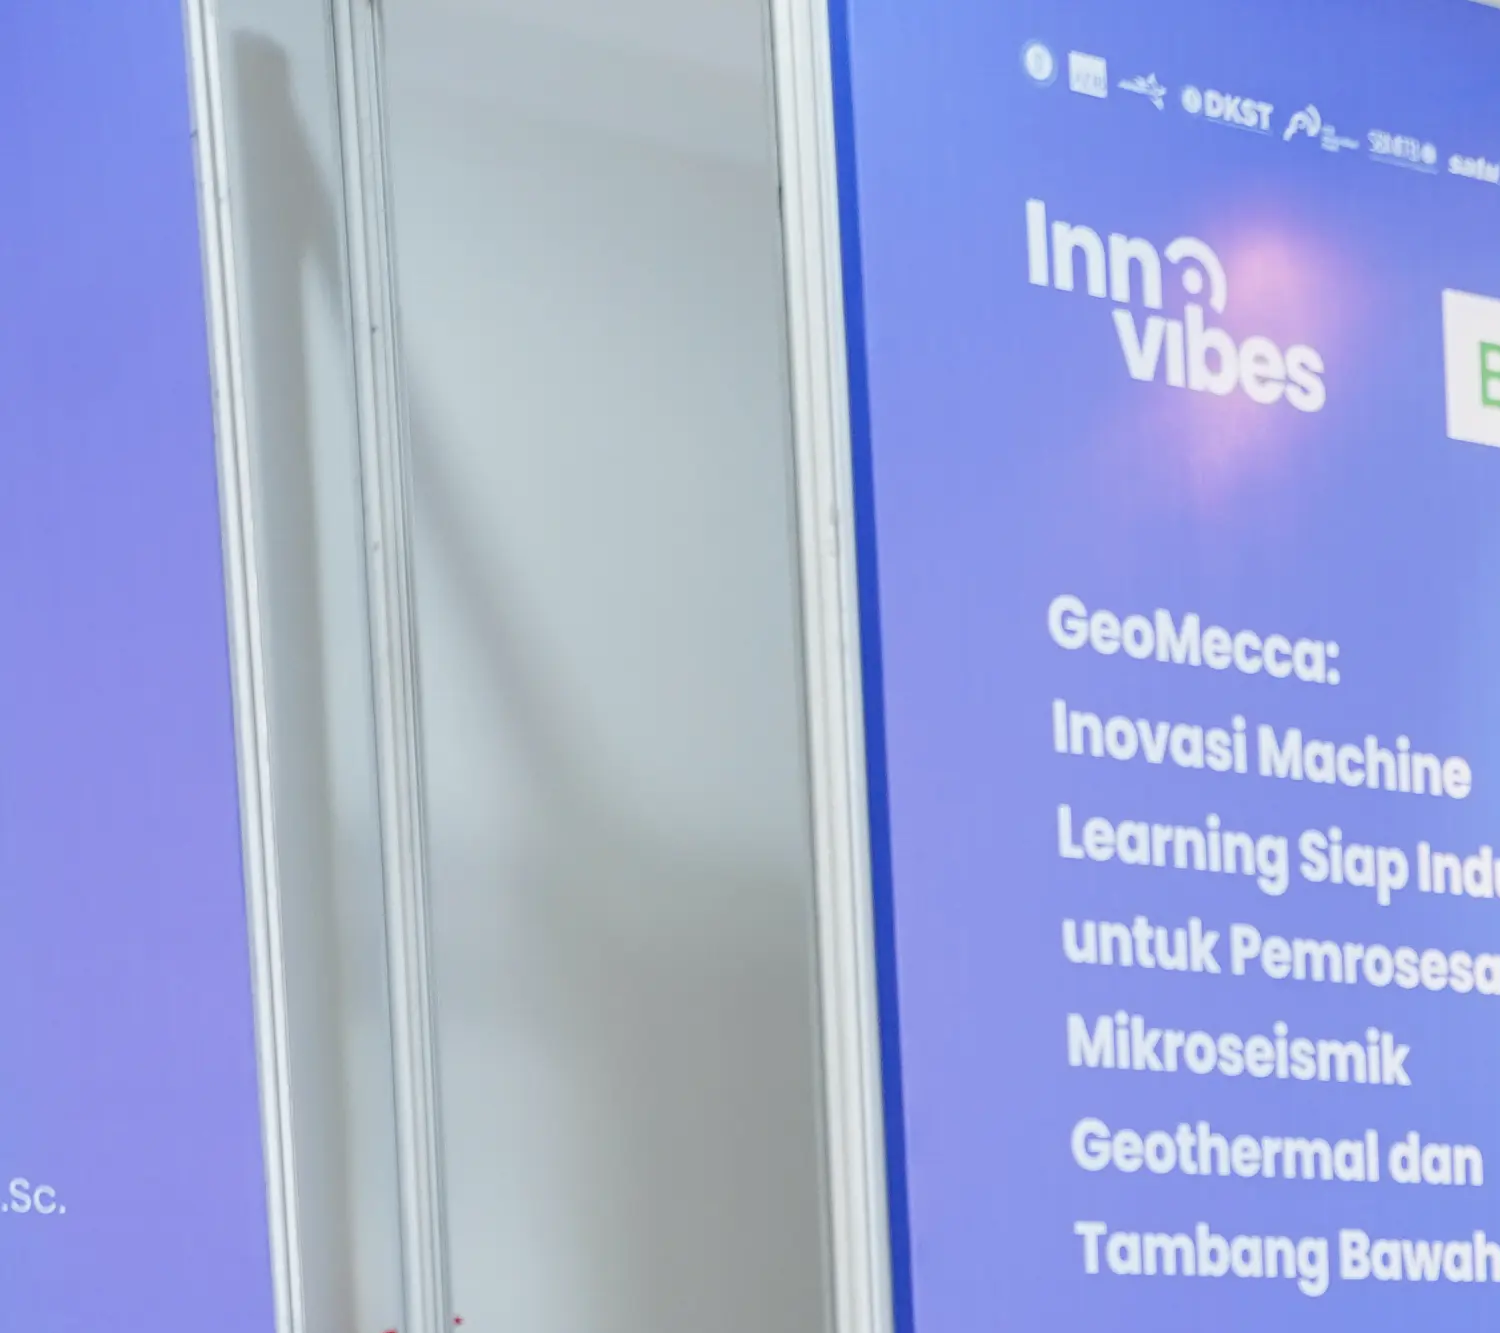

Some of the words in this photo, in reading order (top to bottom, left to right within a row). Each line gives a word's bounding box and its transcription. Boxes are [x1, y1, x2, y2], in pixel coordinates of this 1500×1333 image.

[1205, 90, 1273, 129] DKST
[1114, 303, 1326, 412] vibes
[1048, 595, 1339, 684] GeoMecca:
[1052, 699, 1247, 774] Inovasi
[1258, 724, 1472, 800] Machine
[1057, 804, 1289, 896] Learning
[1298, 827, 1409, 906] Siap
[1062, 915, 1220, 974] untuk
[1067, 1010, 1412, 1086] Mikroseismik
[1070, 1116, 1379, 1182] Geothermal
[1388, 1130, 1484, 1187] dan
[0, 1177, 66, 1214] .Sc.
[1073, 1221, 1330, 1298] Tambang
